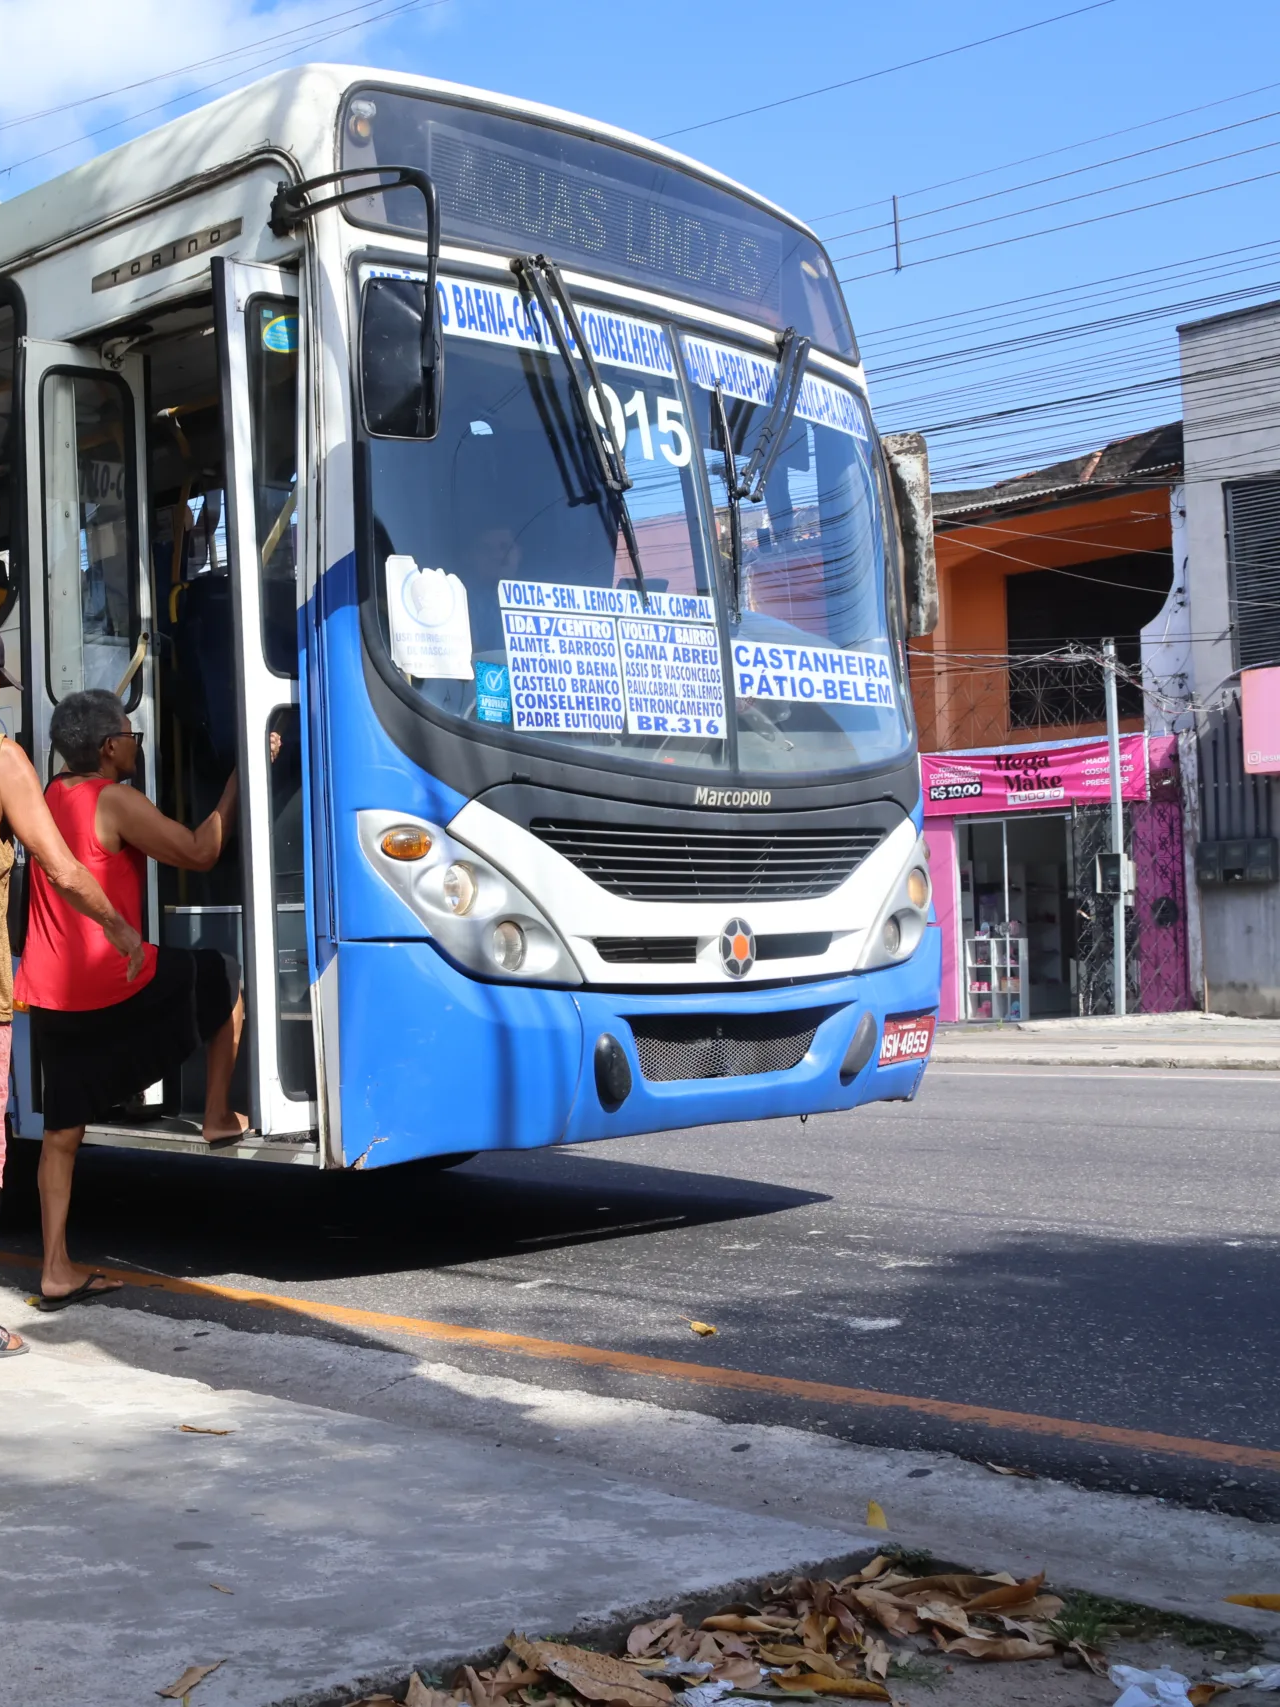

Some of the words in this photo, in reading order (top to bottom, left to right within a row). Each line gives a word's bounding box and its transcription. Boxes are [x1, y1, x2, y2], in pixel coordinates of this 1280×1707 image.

[452, 150, 607, 253] AGUAS
[627, 200, 762, 298] LINDAS
[111, 229, 221, 283] TORINO
[588, 382, 692, 468] 915
[502, 583, 581, 609] VOLTA-SEN.
[670, 596, 712, 619] CABRAL
[509, 615, 537, 634] IDA
[540, 617, 612, 640] P/CENTRO
[622, 622, 657, 641] VOLTA
[675, 627, 715, 646] BAIRRO
[509, 637, 555, 654] ALMTE.
[559, 639, 616, 657] BARROSO
[624, 642, 668, 661] GAMA
[672, 646, 719, 665] ABREU
[511, 654, 571, 674] ANTÔNIO
[577, 661, 618, 677] BAENA
[625, 662, 649, 677] ASSIS
[651, 664, 662, 678] DE
[664, 665, 721, 683] VASCONCELOS
[734, 645, 890, 680] CASTANHEIRA
[513, 675, 567, 692] CASTELO
[571, 678, 620, 695] BRANCO
[739, 669, 893, 705] PÁTIO-BELÉM
[514, 693, 621, 712] CONSELHEIRO
[629, 697, 723, 717] ENTRONCAMENTO
[517, 712, 560, 727] PADRE
[565, 713, 624, 730] EUTIQUIO
[637, 715, 719, 734] BR.316
[993, 755, 1050, 776] Mega
[931, 786, 946, 799] R$
[948, 784, 981, 798] 10,00
[1004, 774, 1062, 792] Make
[694, 786, 771, 808] Marcopolo
[1011, 791, 1045, 803] TUDO
